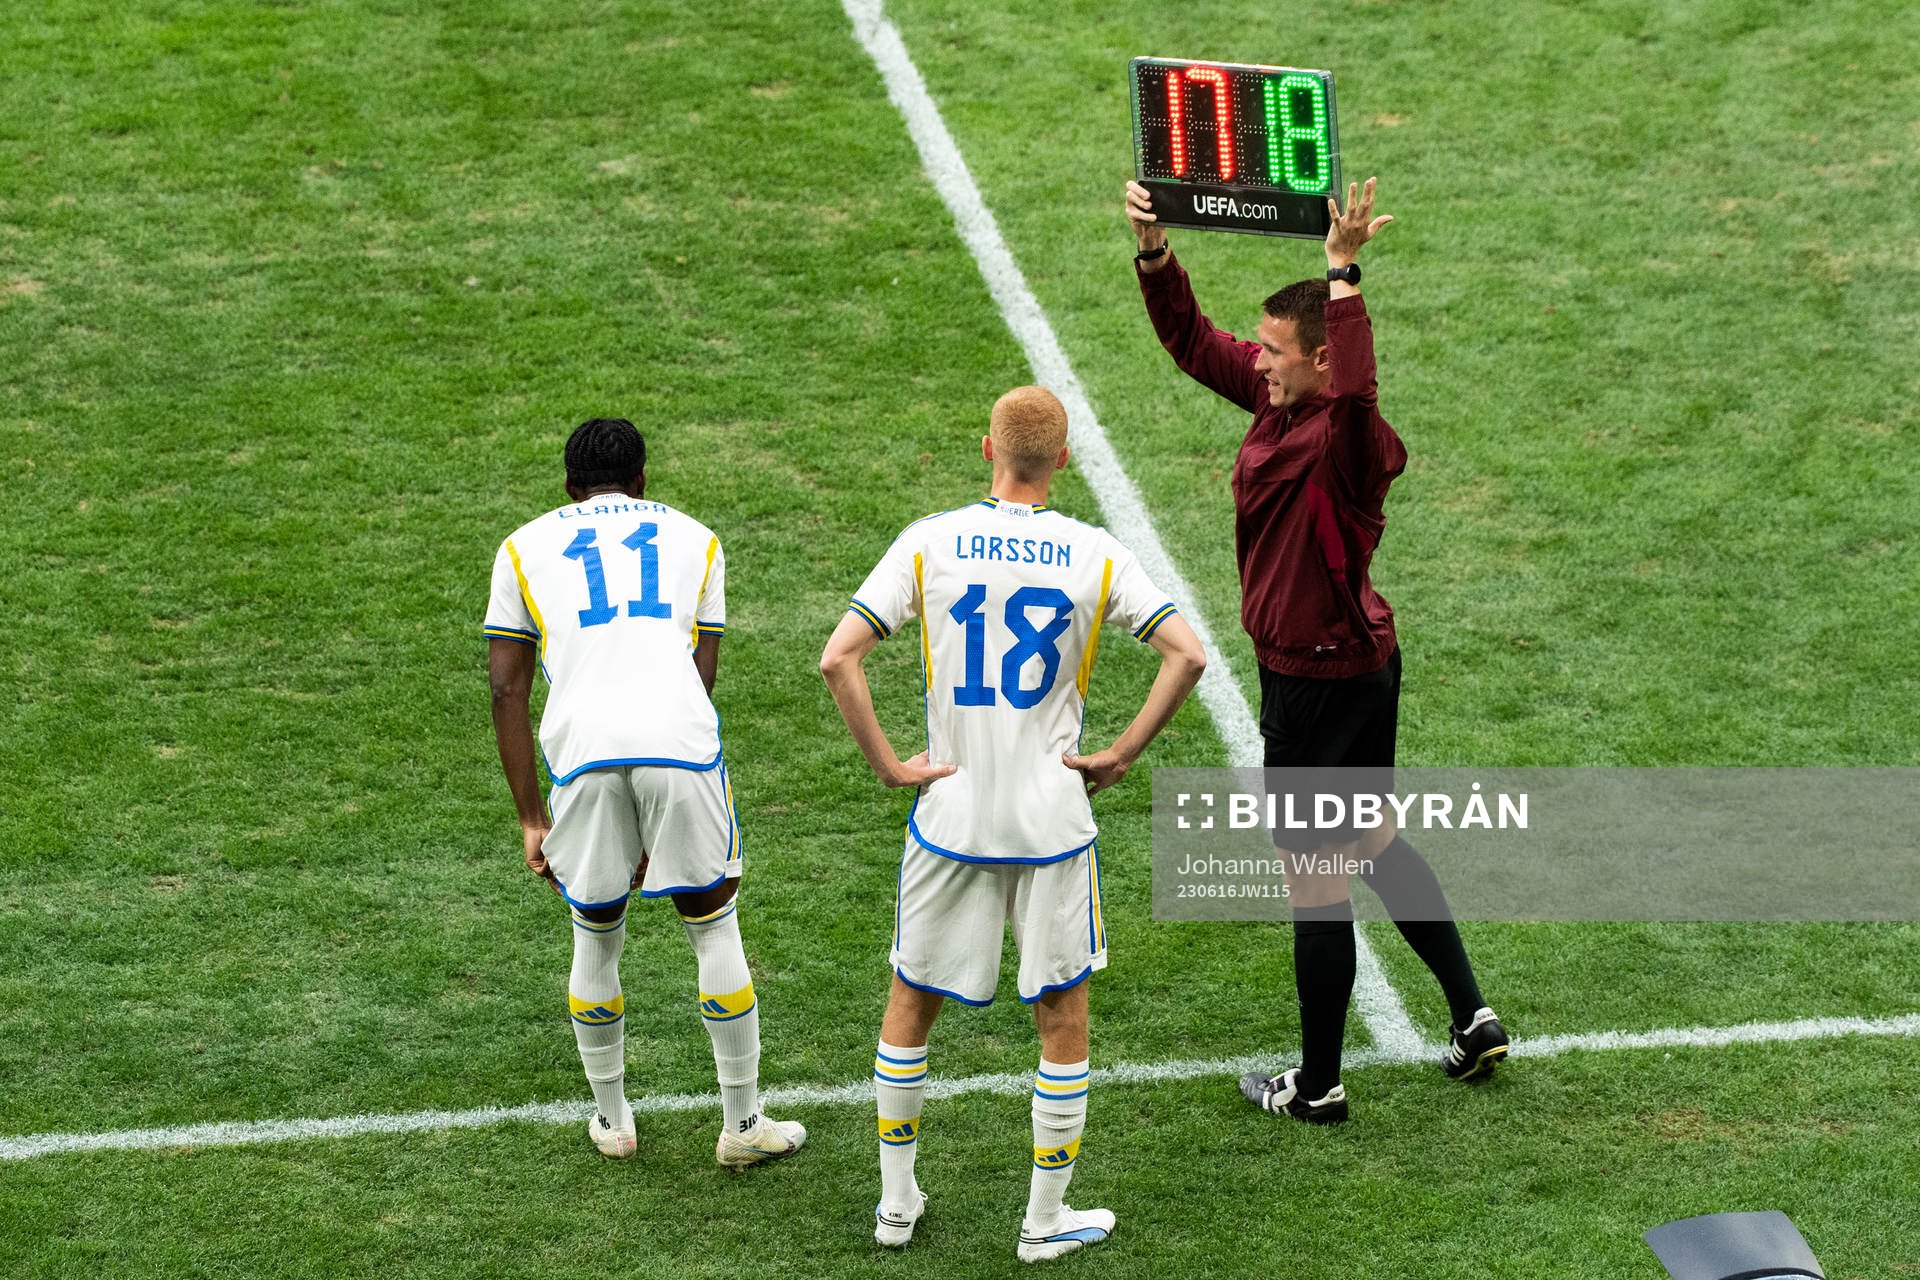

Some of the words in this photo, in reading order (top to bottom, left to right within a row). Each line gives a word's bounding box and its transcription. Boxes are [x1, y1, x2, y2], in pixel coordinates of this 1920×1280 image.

[1167, 66, 1235, 181] 17
[1263, 74, 1329, 192] 18
[1193, 195, 1278, 220] UEFA.com
[562, 522, 672, 628] 11
[956, 535, 1071, 567] LARSSON
[949, 584, 1075, 709] 18
